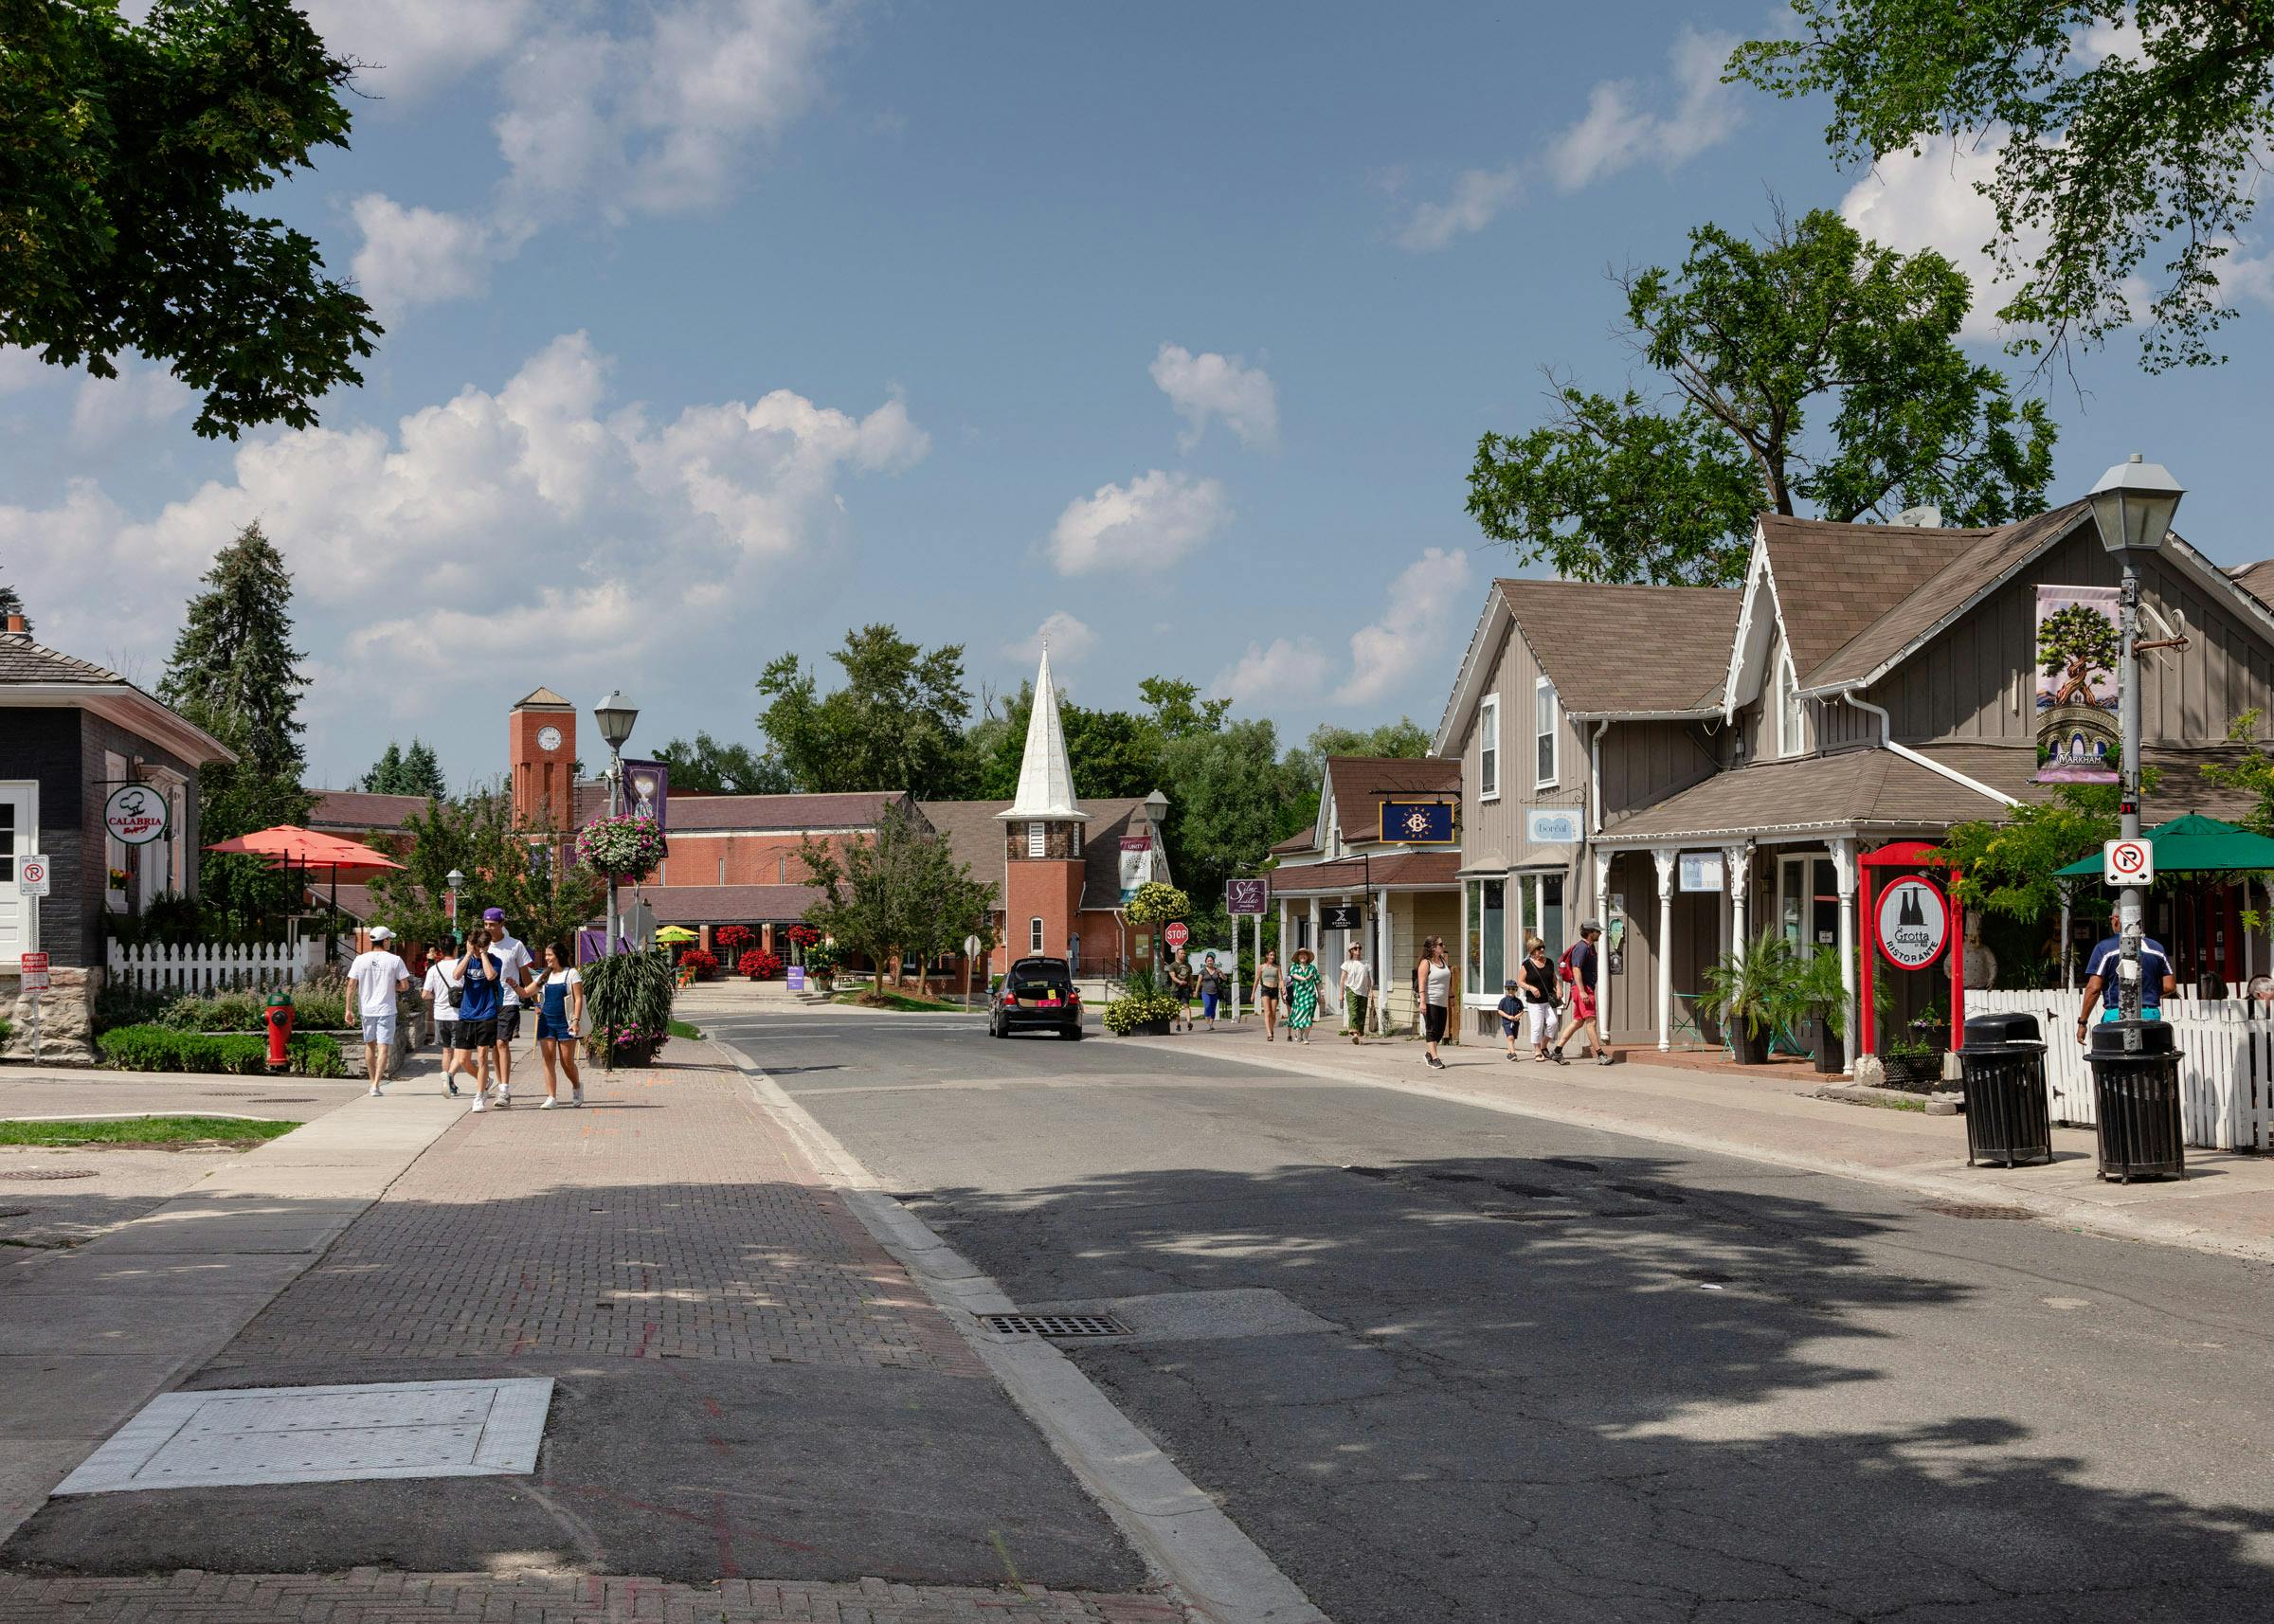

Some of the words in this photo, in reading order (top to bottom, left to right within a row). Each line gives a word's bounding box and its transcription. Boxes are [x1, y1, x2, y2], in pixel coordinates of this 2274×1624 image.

[2057, 751, 2102, 767] MARKHAM
[1167, 929, 1187, 939] STOP
[1895, 930, 1930, 941] Grotta
[1886, 941, 1939, 963] RISTORANTE
